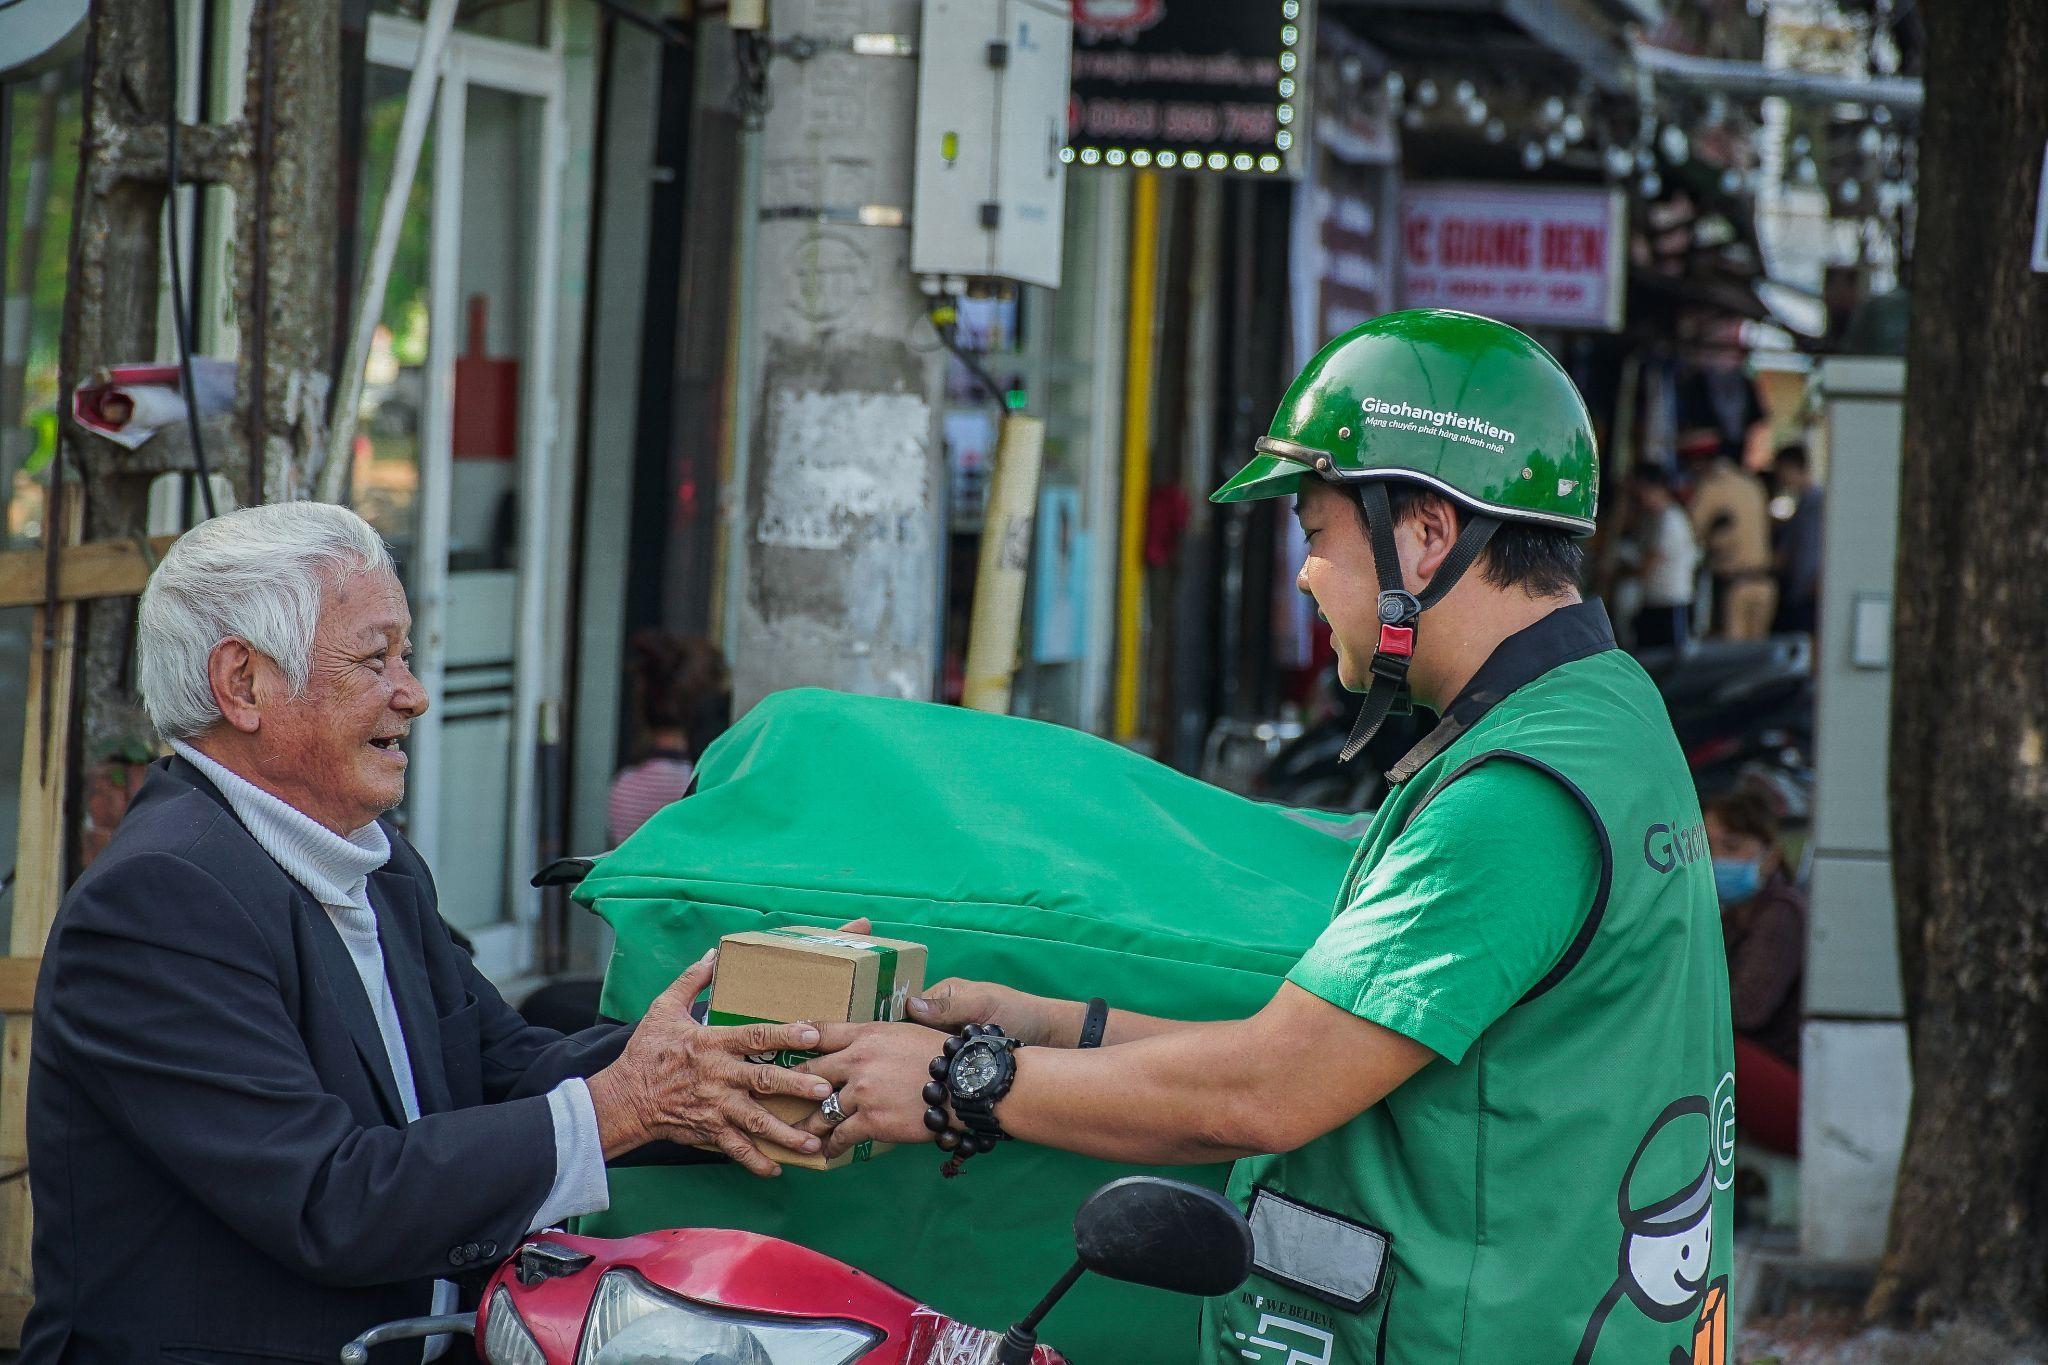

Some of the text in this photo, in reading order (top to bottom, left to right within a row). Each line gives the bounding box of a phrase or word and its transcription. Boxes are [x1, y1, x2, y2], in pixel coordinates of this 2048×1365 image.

[1361, 397, 1516, 444] Giaohangtietkiem
[1460, 434, 1485, 448] nhanh
[1266, 1298, 1287, 1314] WE
[1288, 1304, 1336, 1329] BELIEVE
